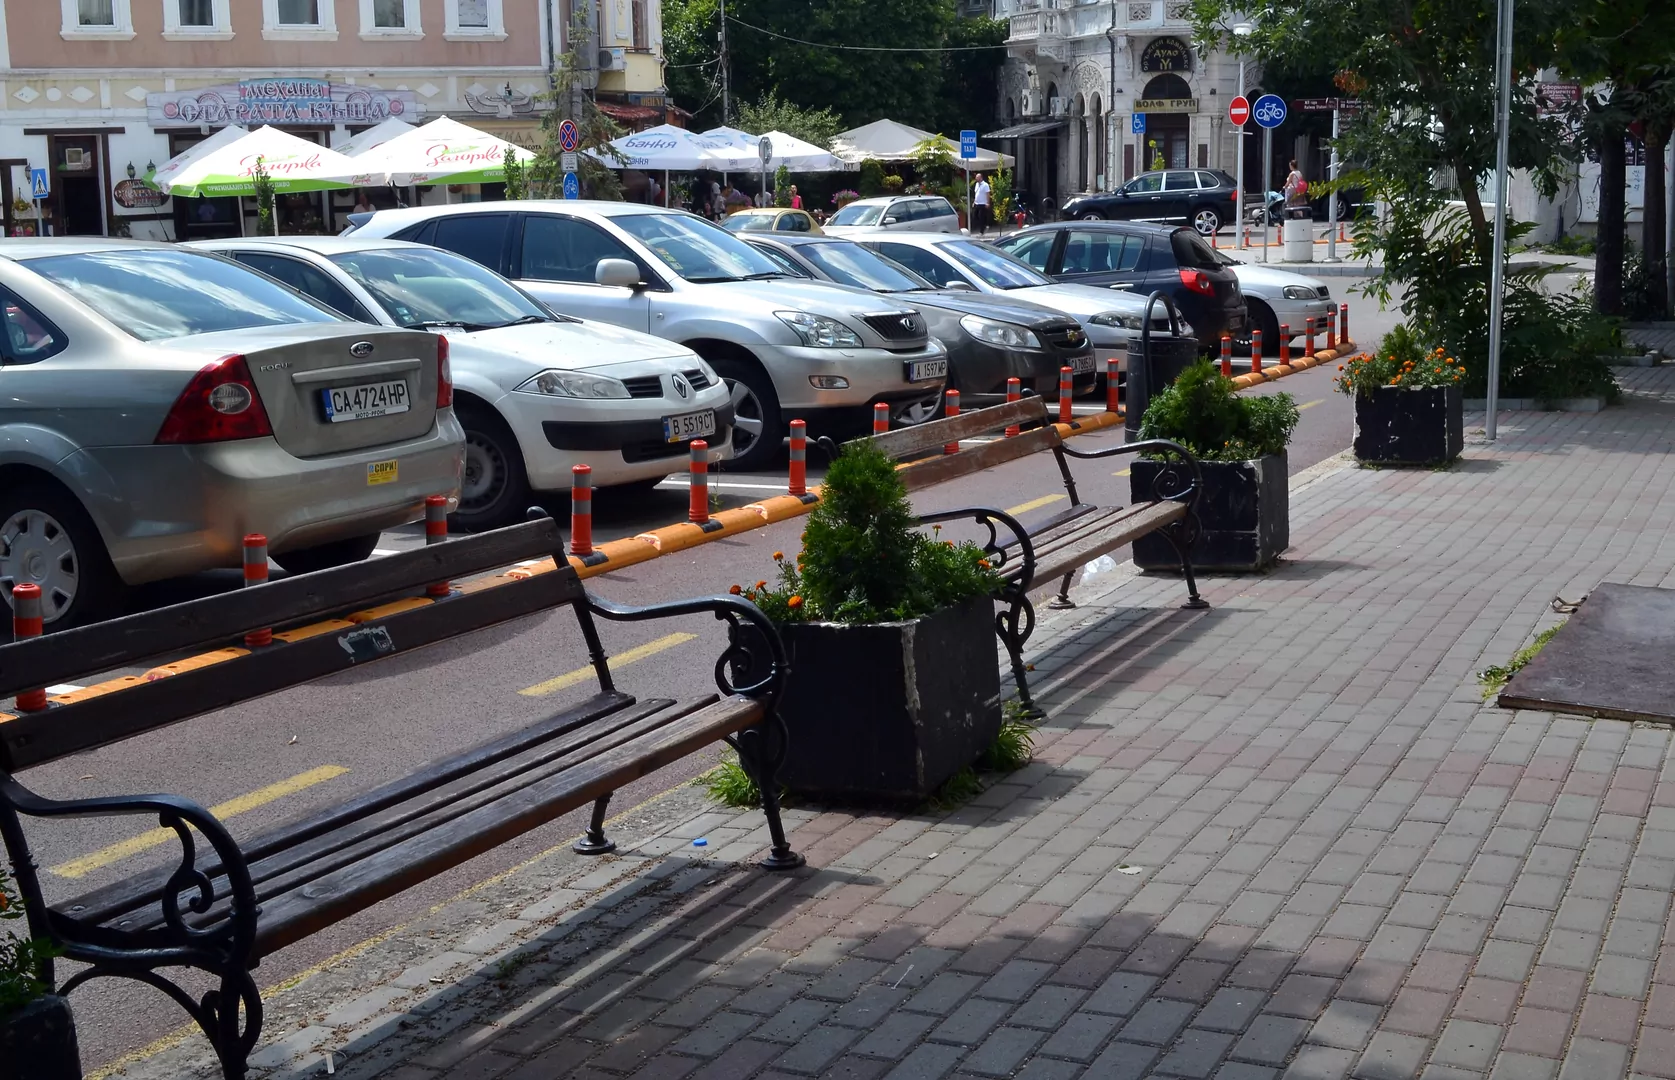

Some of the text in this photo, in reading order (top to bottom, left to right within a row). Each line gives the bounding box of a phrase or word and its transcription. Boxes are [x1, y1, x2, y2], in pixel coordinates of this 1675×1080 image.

[1153, 49, 1179, 58] ДУЛО
[1135, 99, 1196, 108] ВОЛФ ГРУП
[625, 138, 678, 149] Банкя
[916, 364, 921, 379] A
[332, 383, 405, 413] CA 4724 HP
[672, 418, 681, 436] B
[375, 461, 397, 473] СПРИ!
